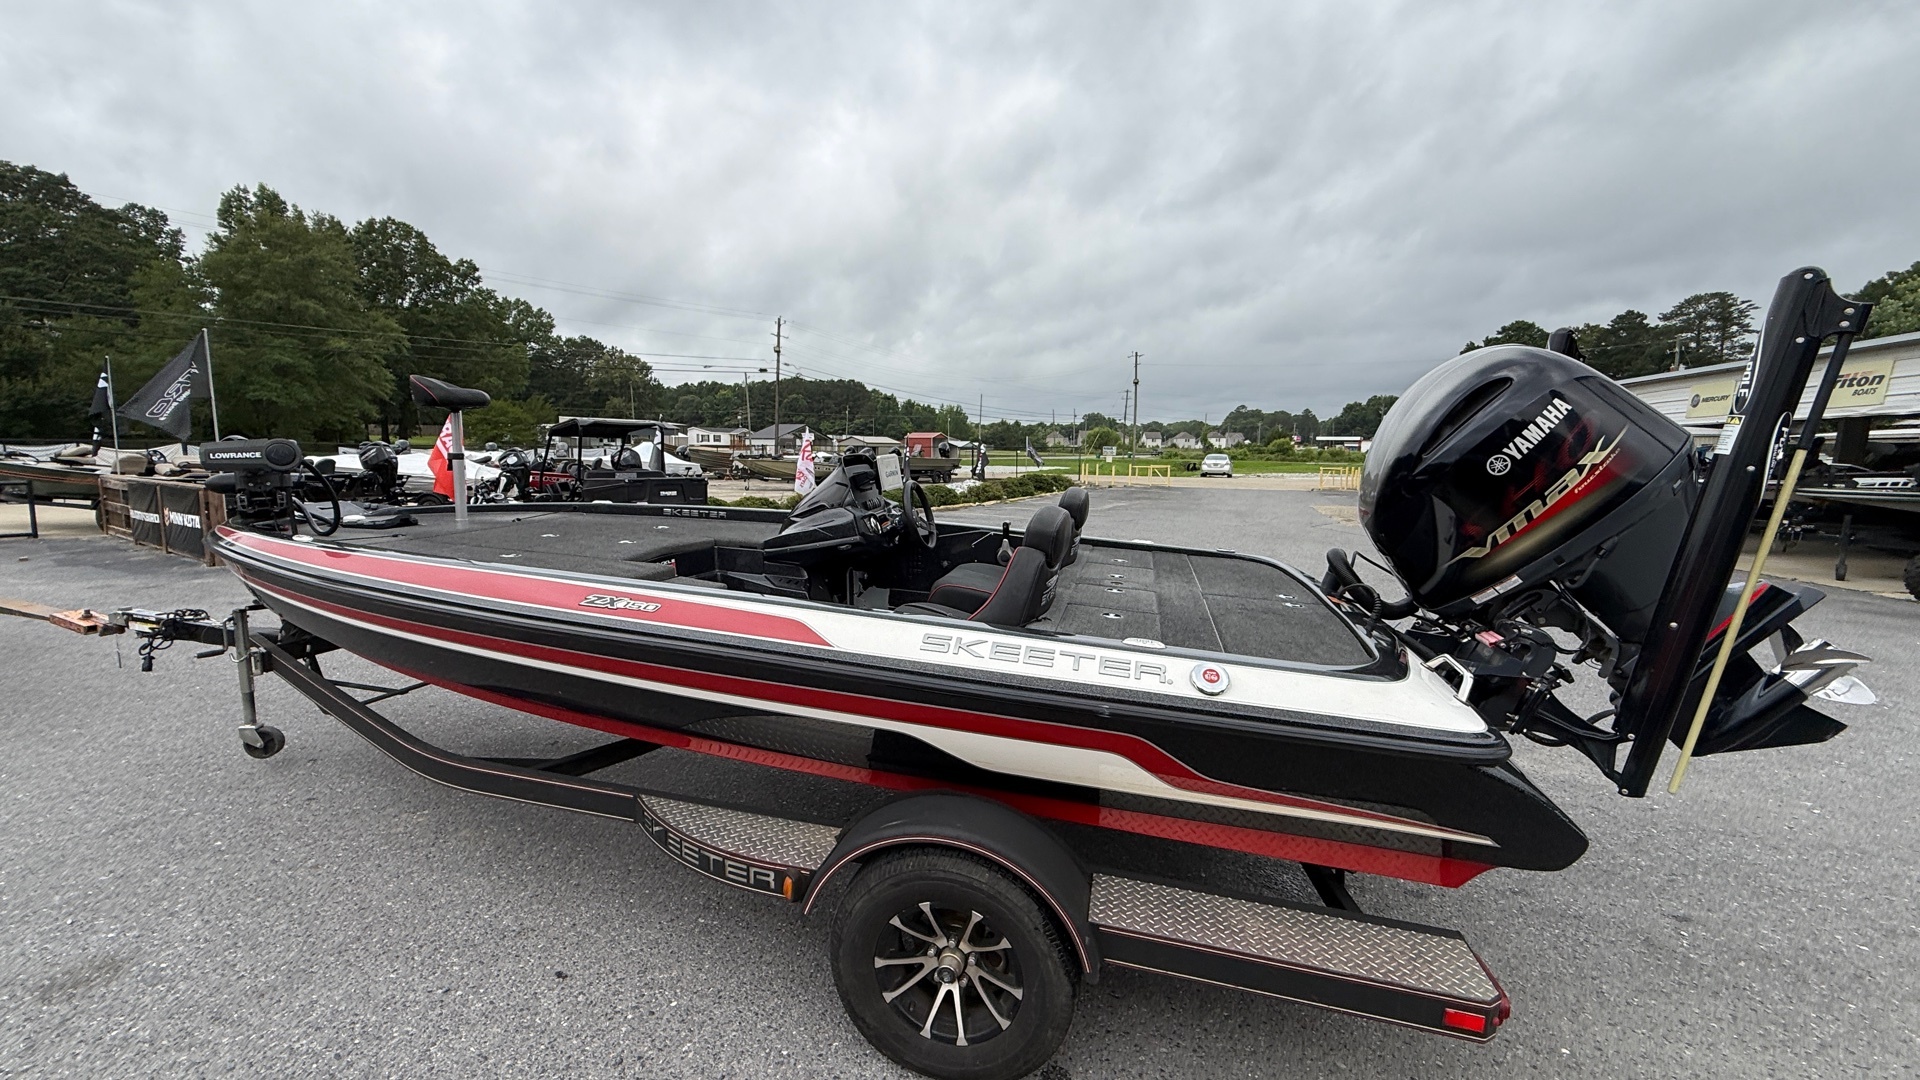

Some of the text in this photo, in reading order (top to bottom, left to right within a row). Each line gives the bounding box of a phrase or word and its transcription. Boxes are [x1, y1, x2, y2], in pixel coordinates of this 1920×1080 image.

[1835, 374, 1886, 389] riton
[1852, 387, 1879, 396] BOATS
[1701, 394, 1731, 403] MERCURY
[1502, 397, 1574, 461] YAMAHA
[209, 451, 262, 459] LOWRANCE
[663, 508, 727, 518] SKEETER
[920, 632, 1168, 684] SKEETER
